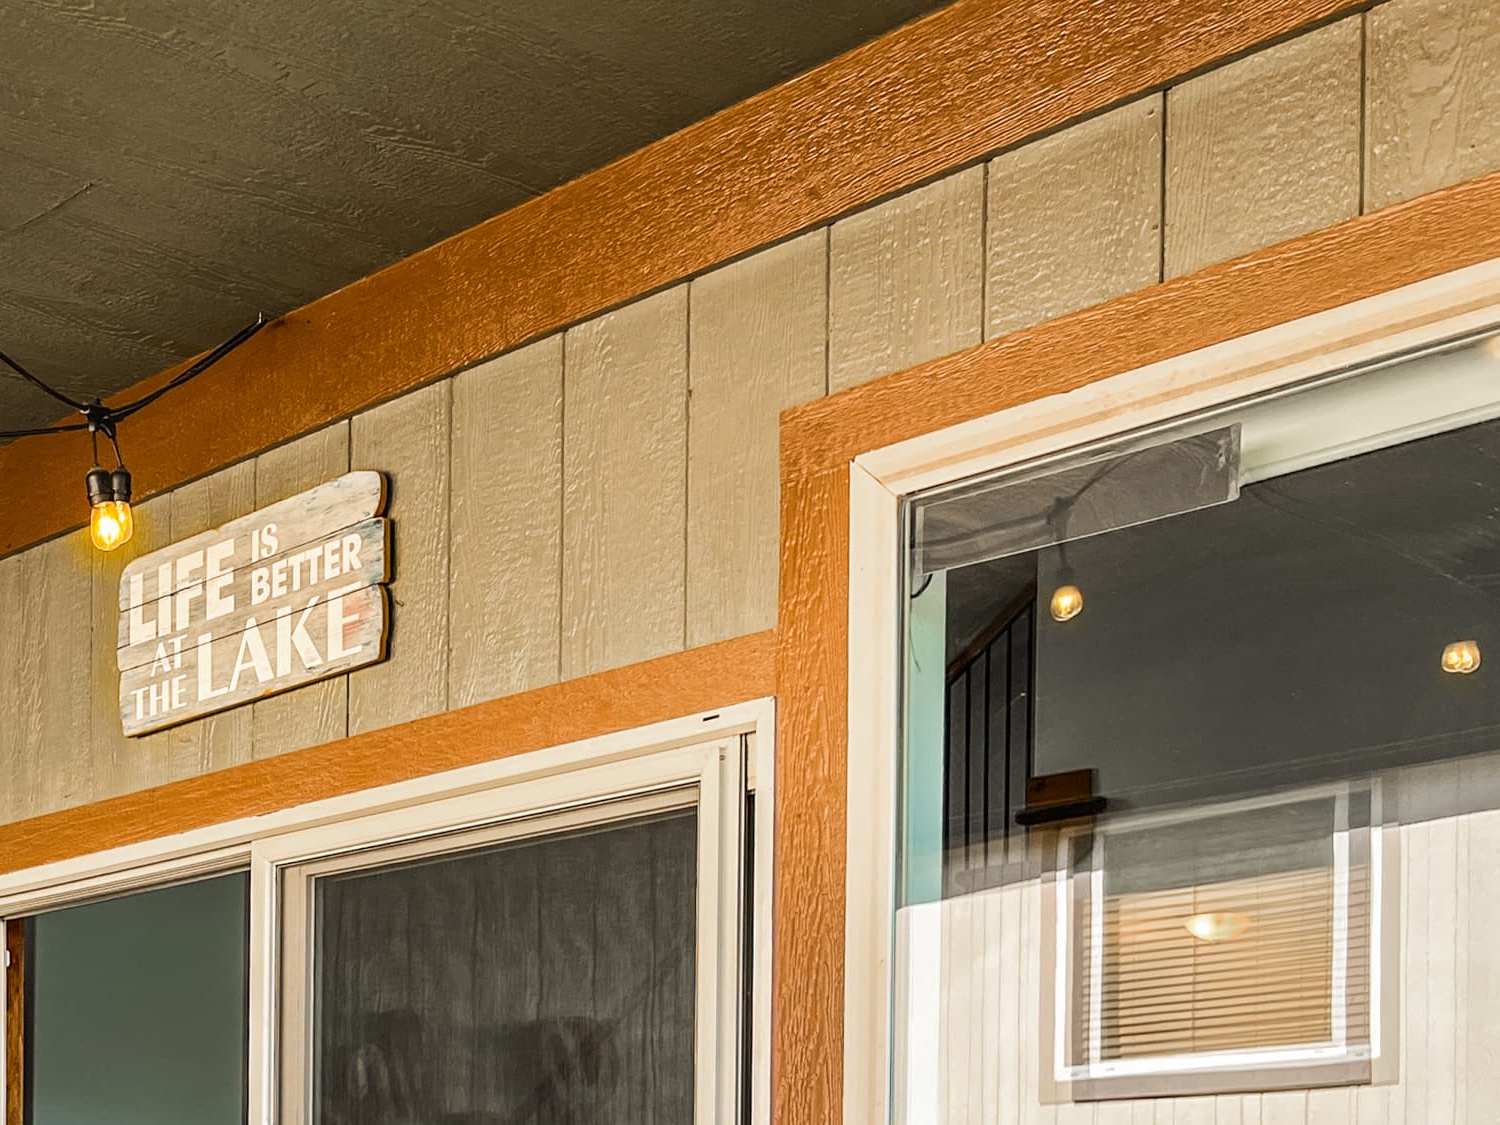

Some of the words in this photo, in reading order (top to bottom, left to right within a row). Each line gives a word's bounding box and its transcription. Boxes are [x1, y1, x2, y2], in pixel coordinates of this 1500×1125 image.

[129, 538, 235, 646] LIFE
[251, 523, 278, 563] IS
[251, 533, 363, 606] BETTER
[130, 674, 187, 720] THE
[198, 581, 363, 702] LAKE
[150, 634, 188, 677] AT
